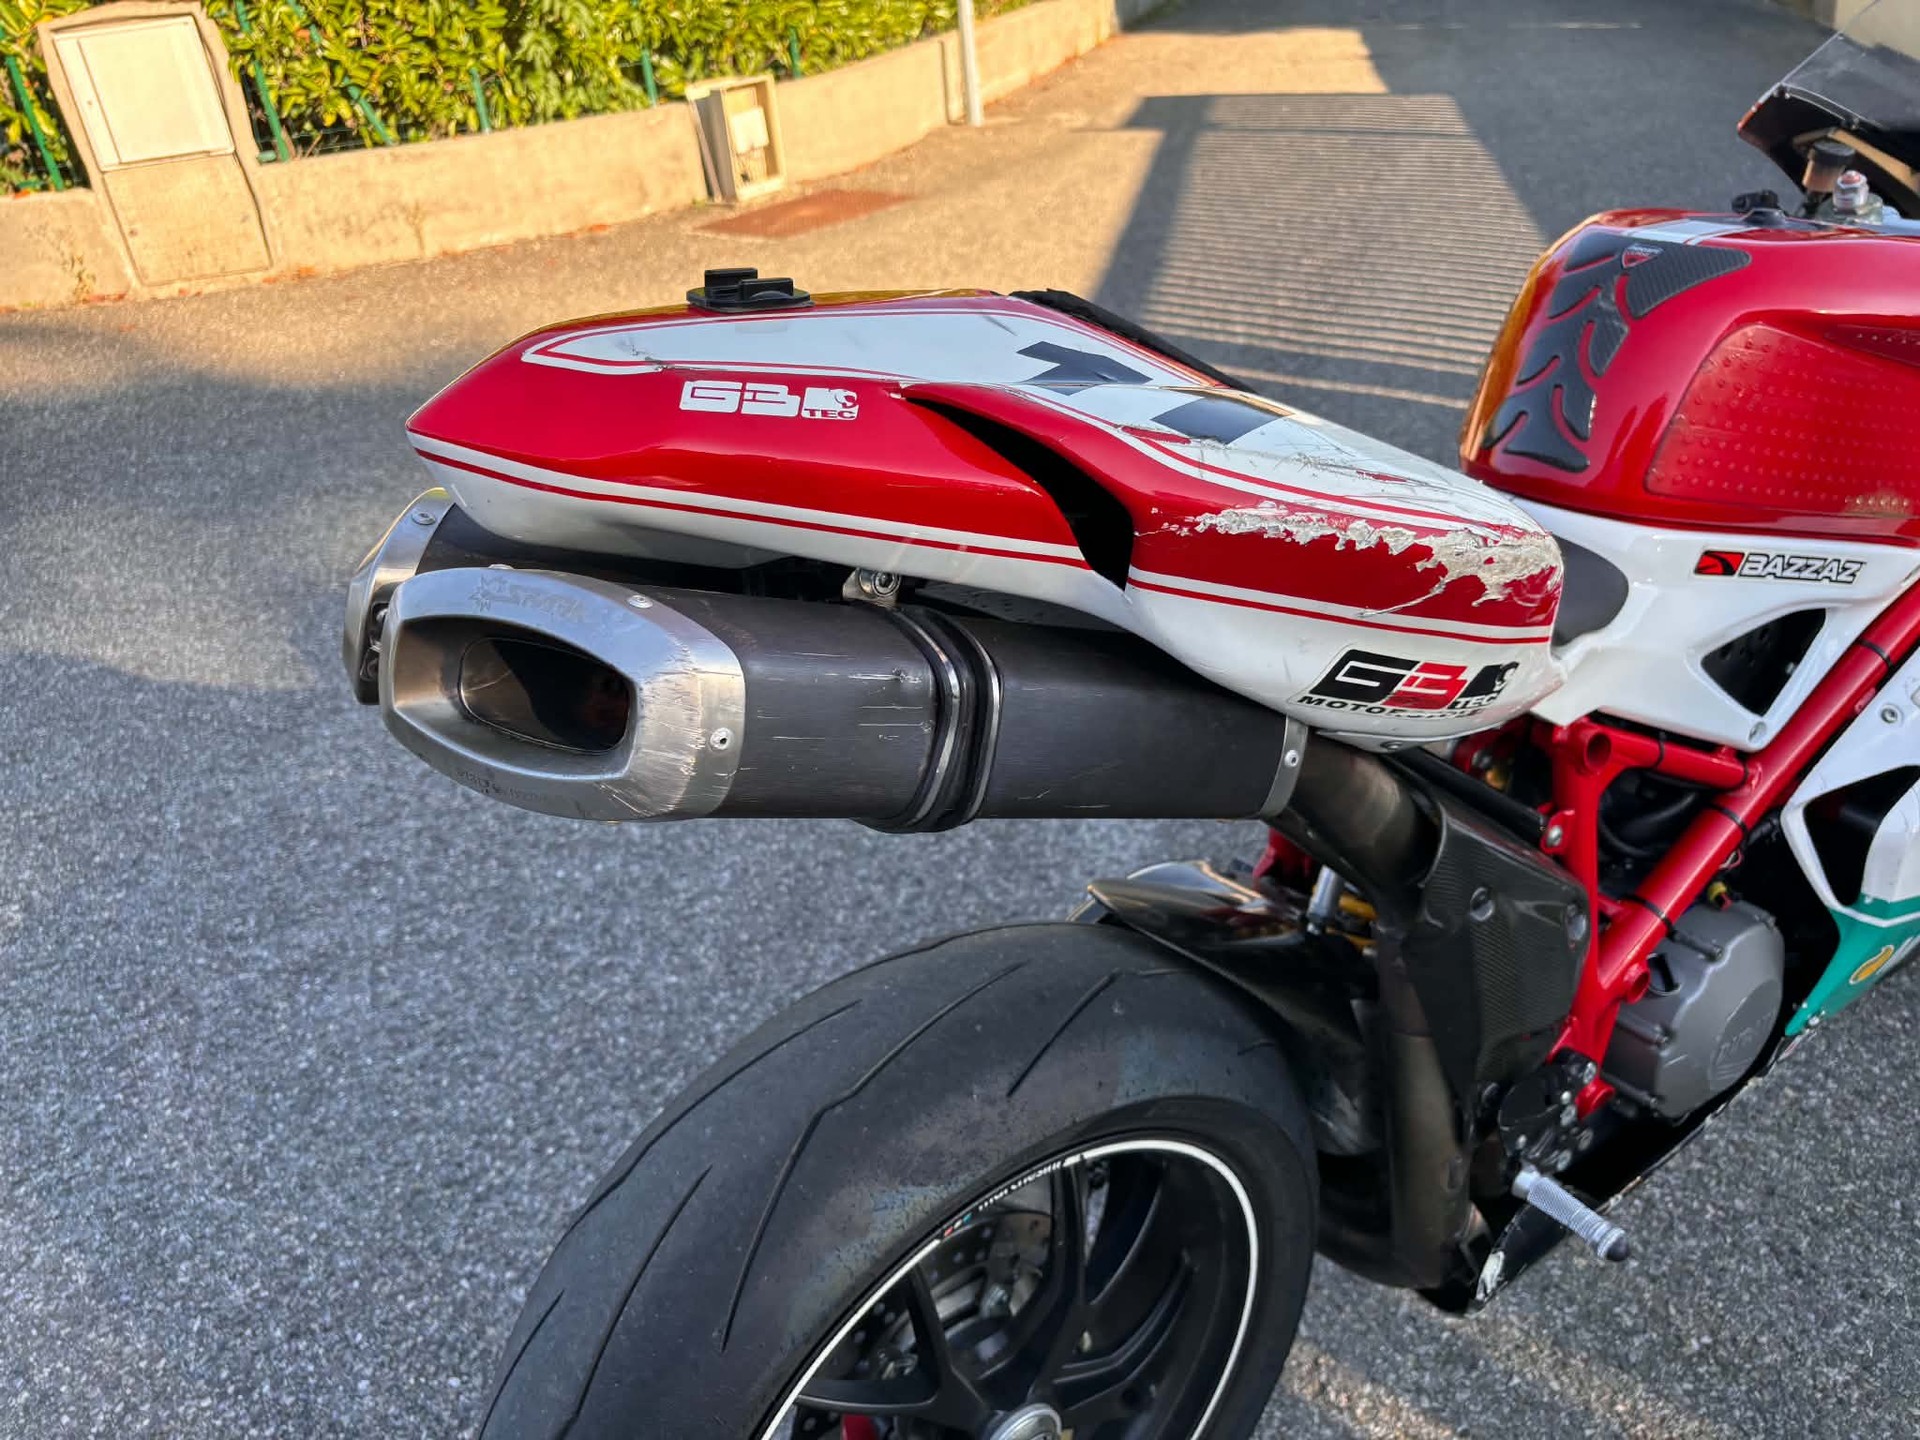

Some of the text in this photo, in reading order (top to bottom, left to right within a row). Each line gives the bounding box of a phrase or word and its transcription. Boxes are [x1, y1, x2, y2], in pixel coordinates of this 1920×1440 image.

[803, 408, 857, 419] TEC
[1739, 553, 1867, 584] BAZZAZ
[1454, 694, 1499, 710] TEC
